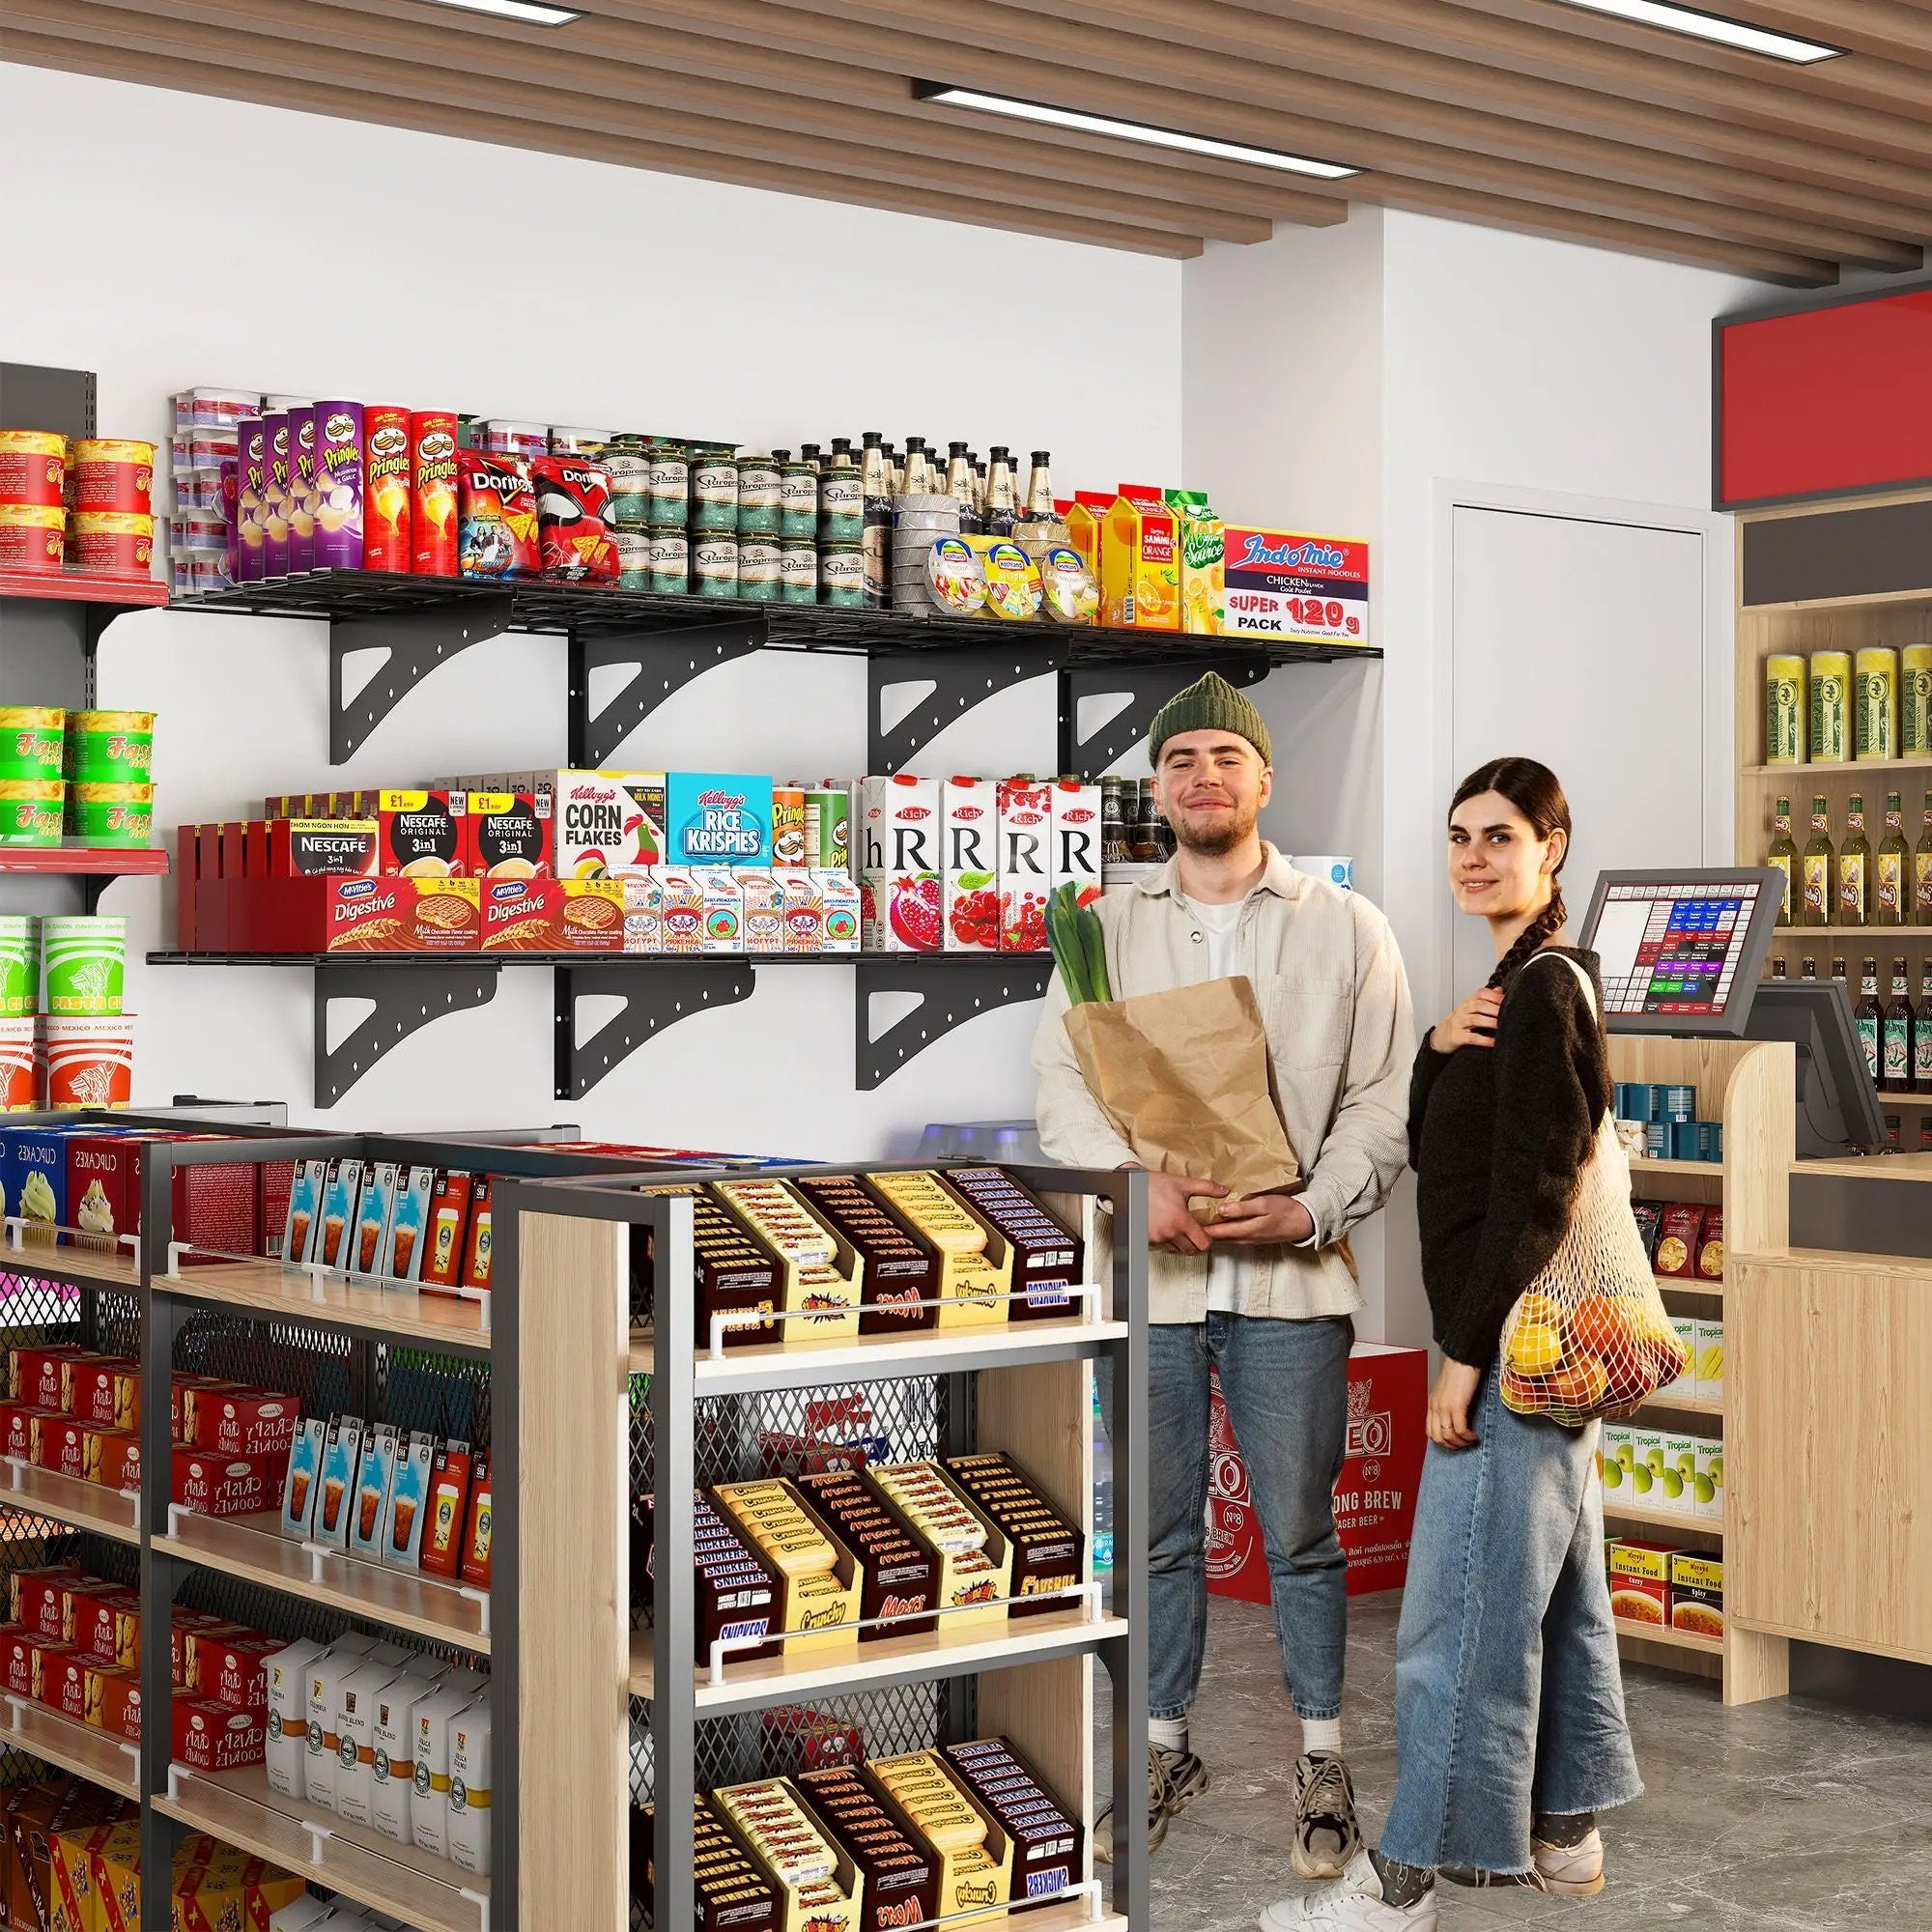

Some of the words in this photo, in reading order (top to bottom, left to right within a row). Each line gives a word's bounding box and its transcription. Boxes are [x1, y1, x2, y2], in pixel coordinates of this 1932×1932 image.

[324, 441, 359, 470] Pringles
[334, 468, 357, 478] MUSHROOM
[369, 452, 410, 485] Pringles
[417, 458, 457, 490] Pringles
[342, 473, 356, 483] GARLIC
[472, 471, 534, 494] Doritos
[1143, 545, 1171, 557] ORANGE
[1327, 569, 1360, 578] NOODLES
[1266, 576, 1307, 587] CHICKEN
[1229, 596, 1279, 612] SUPER
[1237, 616, 1282, 631] PACK
[390, 794, 403, 808] £1
[450, 796, 464, 806] NEW
[570, 785, 616, 804] Kellogg's
[646, 792, 665, 802] MONEY
[697, 789, 746, 810] Kellogg's
[478, 797, 490, 809] £1
[536, 799, 550, 808] NEW
[565, 804, 622, 829] CORN
[706, 810, 742, 831] RICE
[900, 810, 928, 819] Rich
[956, 809, 980, 818] Rich
[1013, 814, 1038, 824] Rich
[1065, 811, 1092, 821] Rich
[565, 830, 623, 846] FLAKES
[687, 828, 760, 856] KRISPIES
[412, 838, 437, 853] 3in1
[498, 839, 523, 854] 3in1
[327, 855, 344, 864] 3in1
[334, 892, 395, 923] Digestive
[488, 893, 545, 923] Digestive
[413, 923, 431, 935] Milk
[561, 923, 579, 935] Milk
[666, 937, 699, 946] РЯЖЕНКА
[747, 937, 780, 946] ЙОГУРТ
[1674, 1323, 1691, 1333] opical
[1346, 1416, 1390, 1456] EO
[1605, 1432, 1631, 1442] Tropical
[1635, 1436, 1661, 1447] Tropical
[1666, 1440, 1691, 1450] Tropical
[1334, 1492, 1358, 1513] ONG
[1364, 1491, 1402, 1511] BREW
[1335, 1520, 1356, 1530] AGER
[1358, 1517, 1378, 1527] BEER
[696, 1538, 739, 1552] NICKERS
[696, 1549, 748, 1565] SNICKERS
[705, 1561, 757, 1577] SNICKERS
[1615, 1562, 1640, 1575] Instant
[1642, 1565, 1659, 1577] Food
[714, 1573, 767, 1589] SNICKERS
[1628, 1577, 1644, 1587] Curry
[1677, 1573, 1703, 1585] Instant
[1705, 1577, 1722, 1589] Food
[1691, 1588, 1707, 1599] Spicy
[801, 1600, 846, 1631] Crunchy
[876, 1594, 926, 1630] Mars
